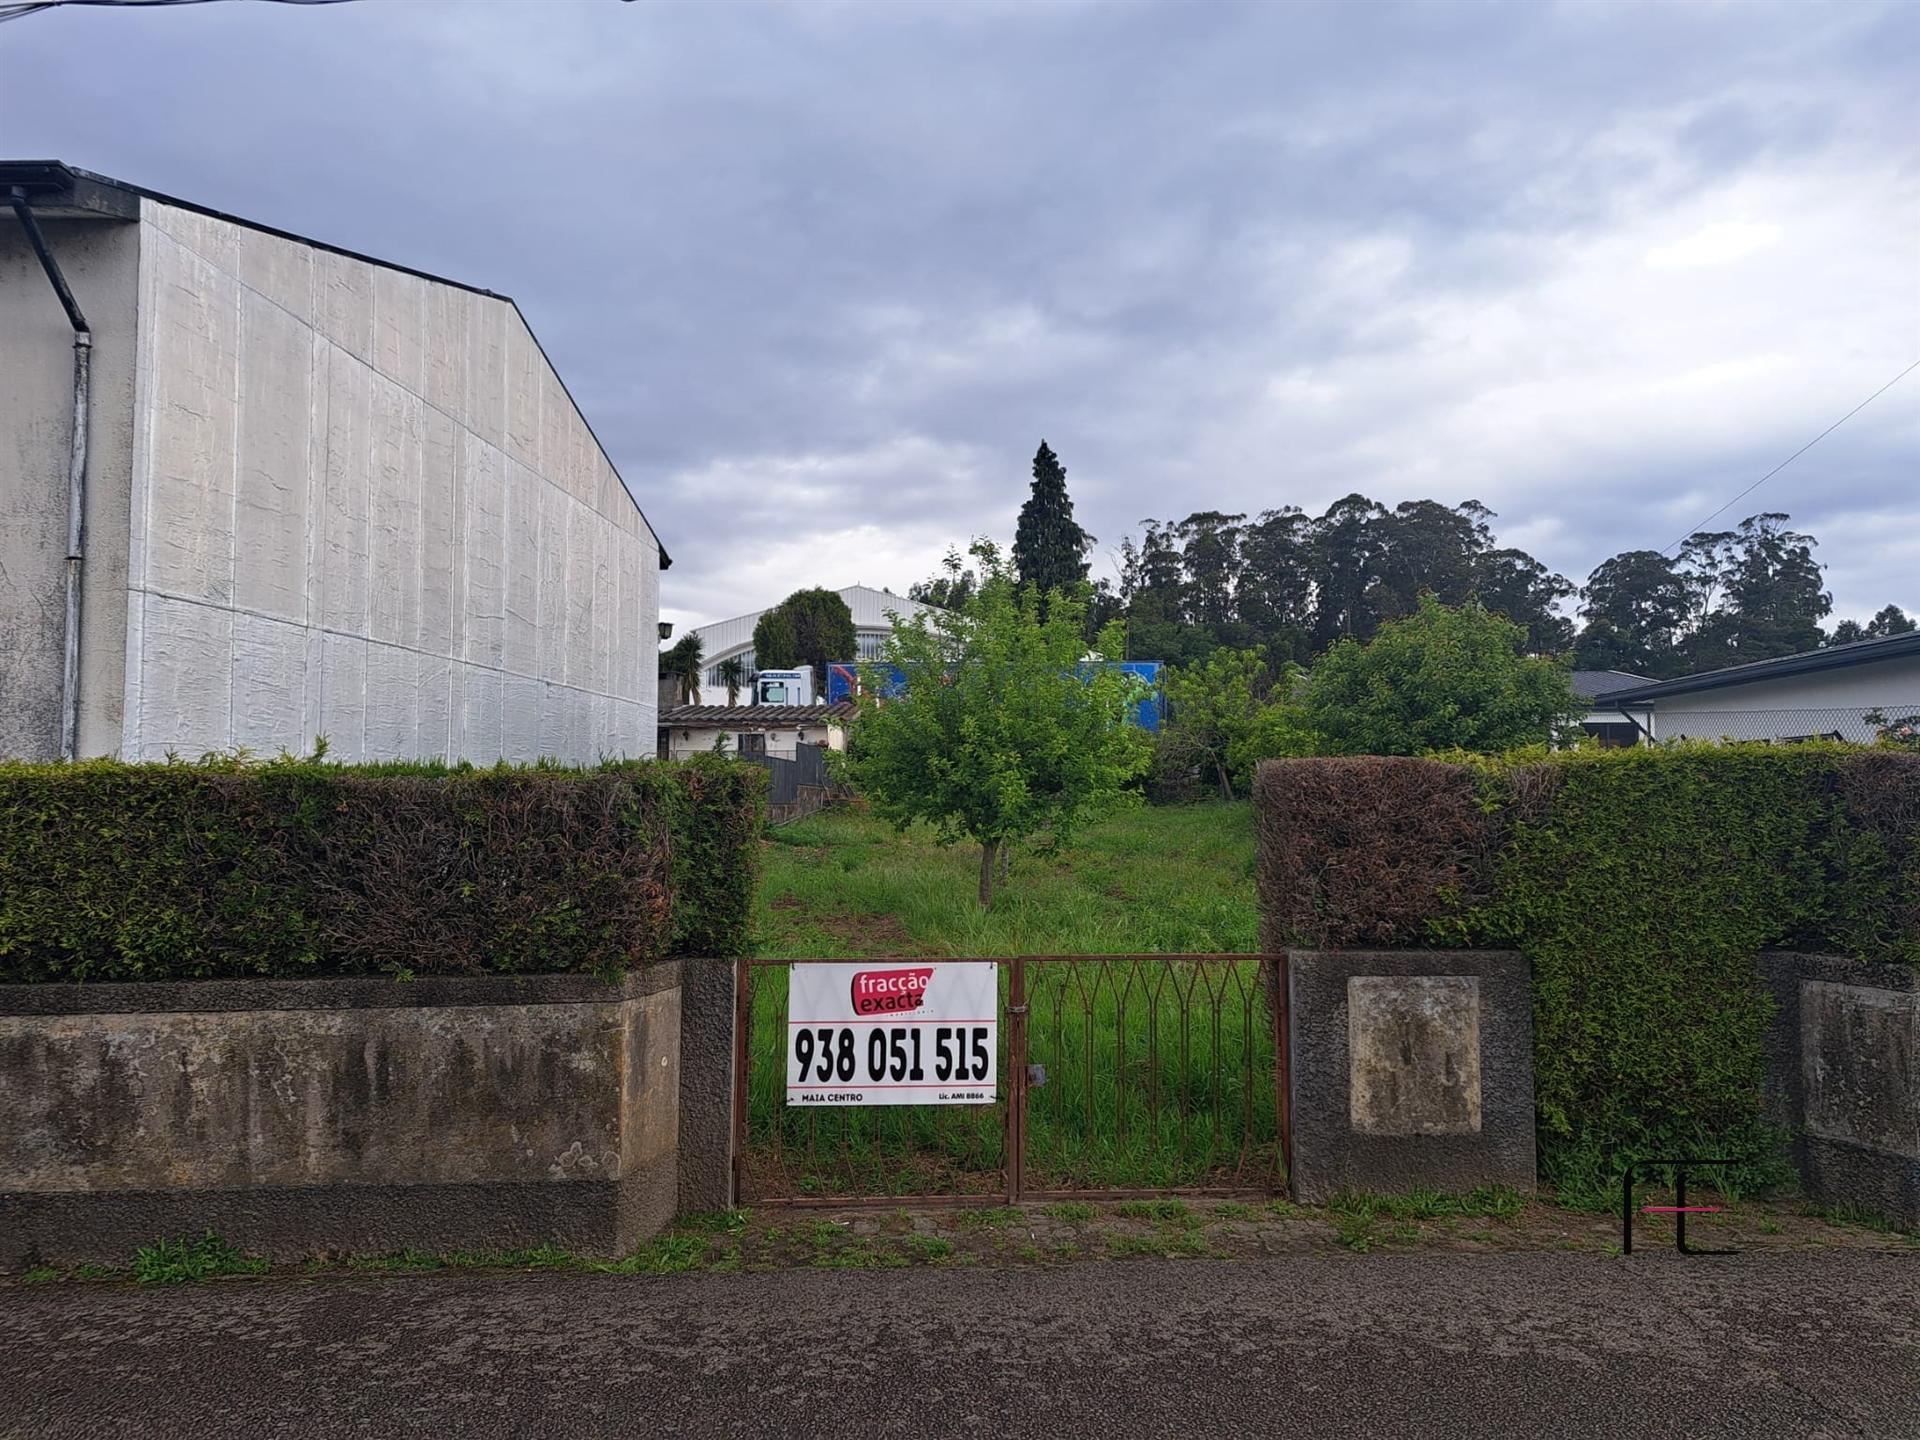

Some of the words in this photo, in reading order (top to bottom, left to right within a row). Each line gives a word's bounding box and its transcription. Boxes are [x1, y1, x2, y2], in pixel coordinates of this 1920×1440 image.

[860, 973, 929, 995] fracção
[861, 992, 924, 1012] exacta
[795, 1028, 856, 1082] 938
[868, 1027, 924, 1082] 051
[935, 1027, 989, 1081] 515
[802, 1094, 825, 1102] MAIA
[828, 1093, 863, 1102] CENTRO
